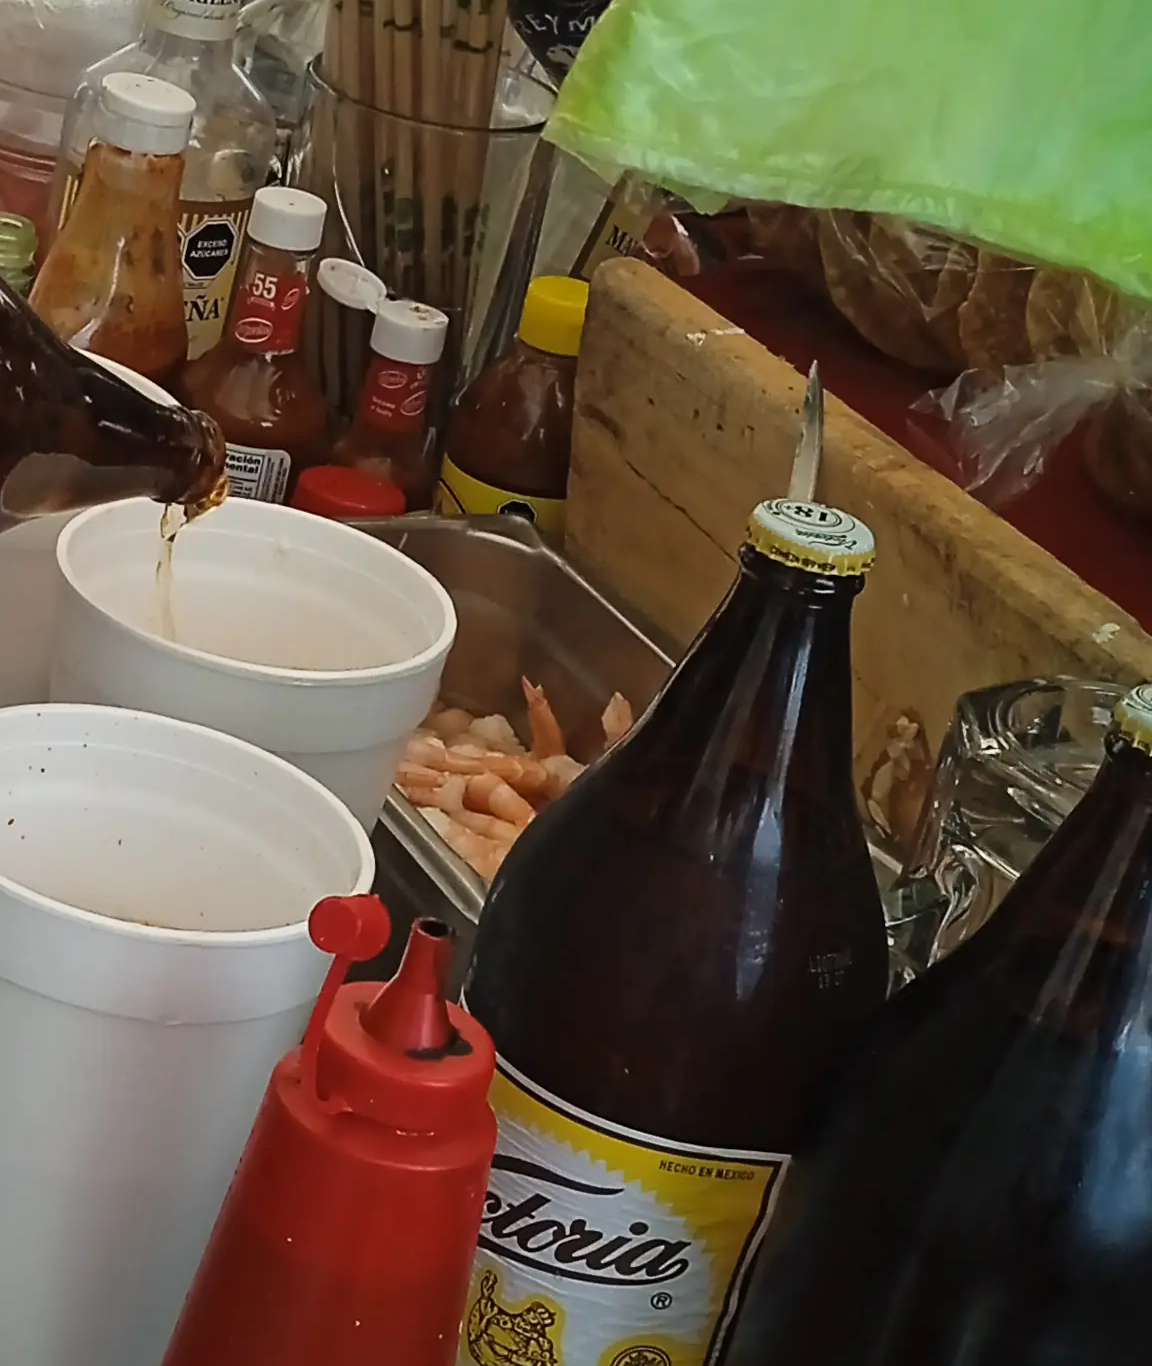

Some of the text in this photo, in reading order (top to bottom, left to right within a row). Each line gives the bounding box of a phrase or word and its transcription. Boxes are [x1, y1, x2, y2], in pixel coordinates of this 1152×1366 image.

[197, 238, 228, 249] EXCESO
[252, 273, 279, 300] 55
[659, 1159, 756, 1182] HECHO EN MEXICO
